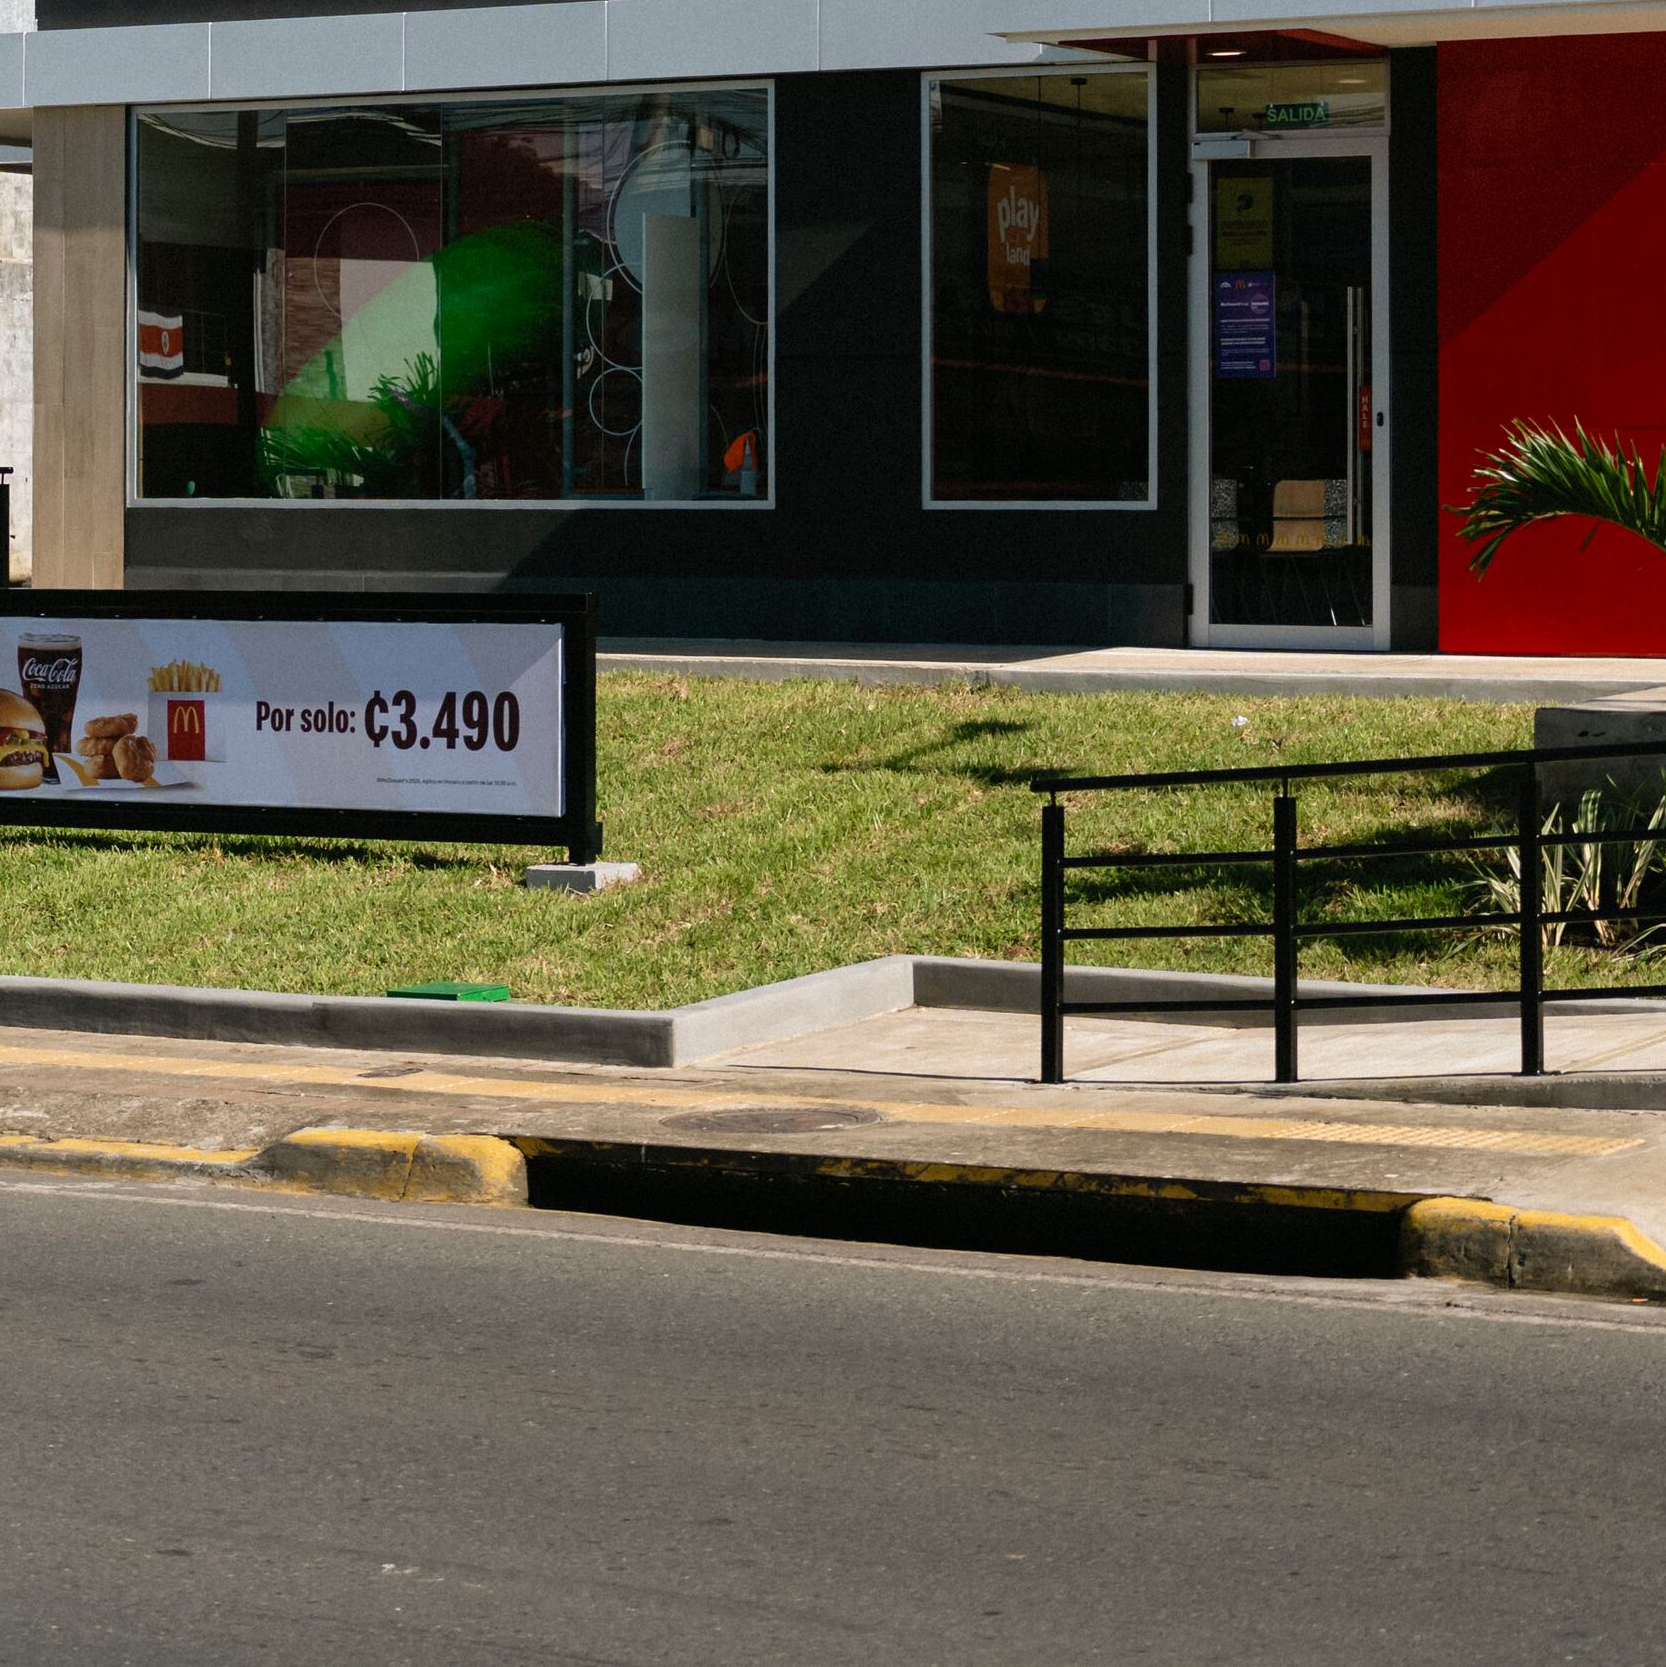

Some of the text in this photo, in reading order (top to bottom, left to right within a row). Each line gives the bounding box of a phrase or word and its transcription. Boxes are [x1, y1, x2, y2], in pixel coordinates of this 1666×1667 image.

[1267, 107, 1326, 122] SALIDA
[997, 184, 1039, 244] play
[1006, 242, 1031, 267] land
[22, 657, 79, 683] Coca-Cola
[256, 701, 295, 732] Por
[300, 701, 356, 733] solo:
